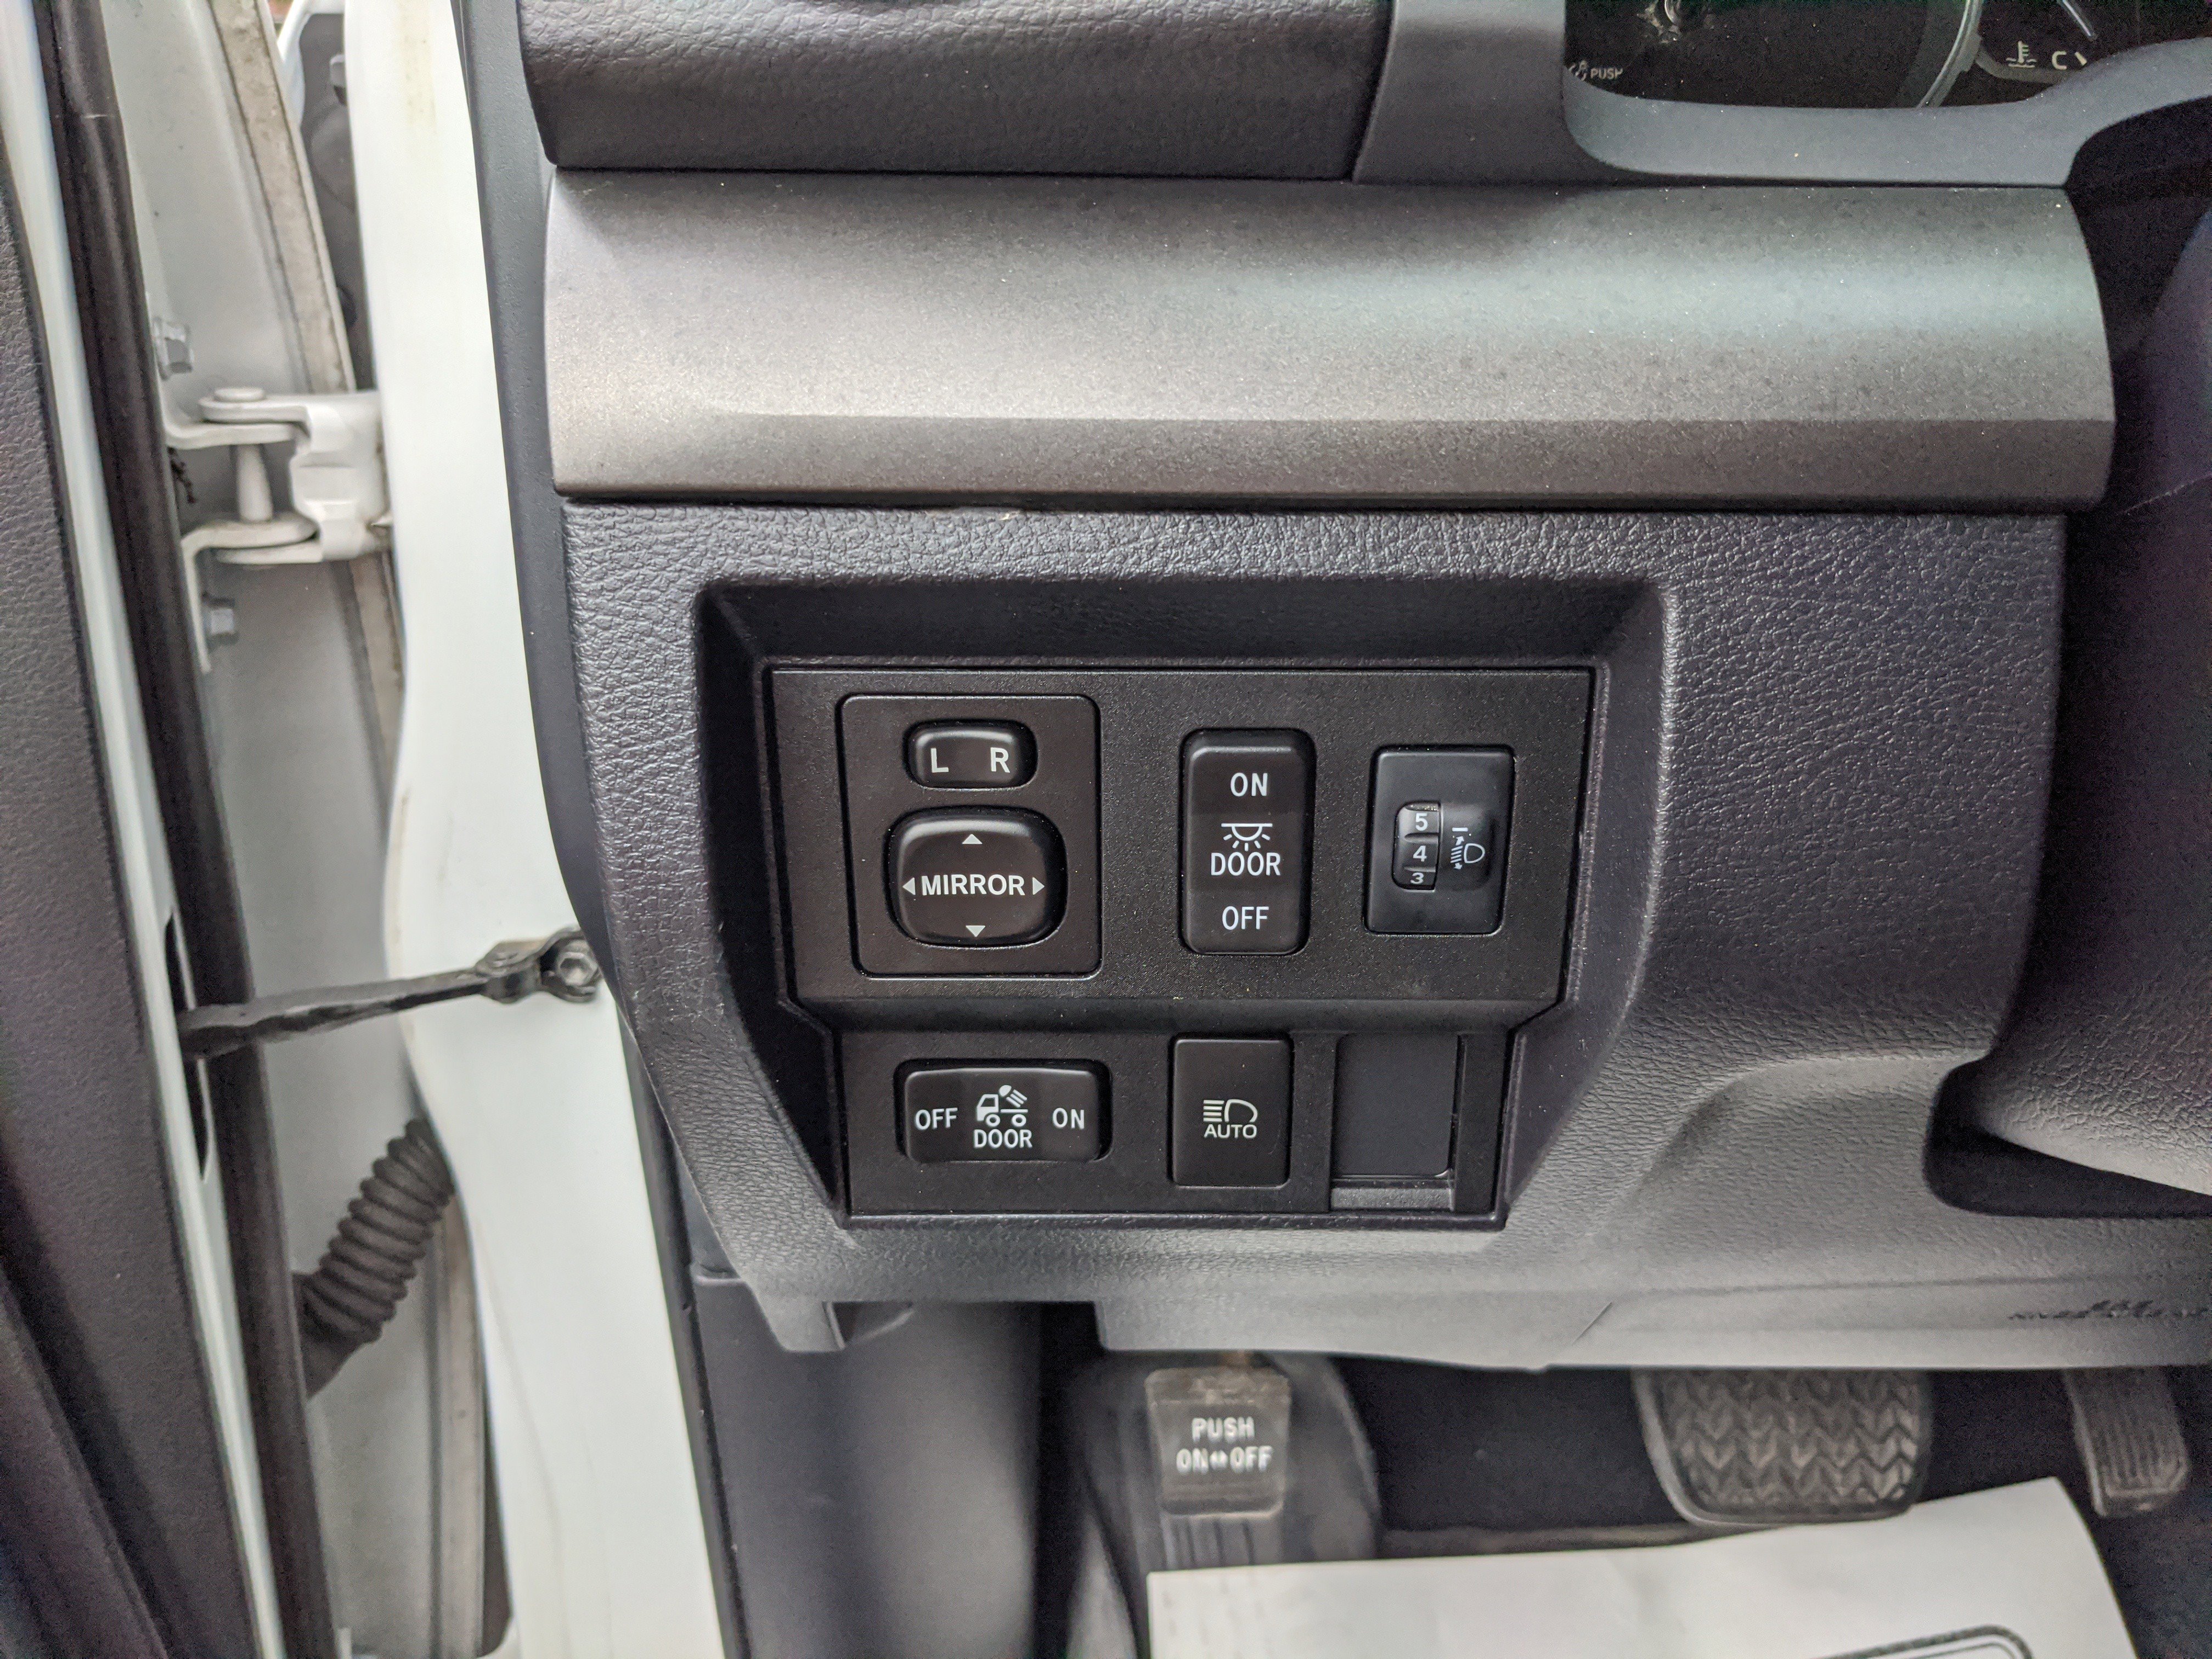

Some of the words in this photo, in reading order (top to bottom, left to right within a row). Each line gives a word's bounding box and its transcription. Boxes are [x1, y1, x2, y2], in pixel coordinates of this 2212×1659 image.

[2051, 50, 2068, 70] C
[930, 747, 949, 773] L
[990, 747, 1011, 773] R
[1229, 772, 1268, 797] ON
[1415, 812, 1428, 832] 5
[1210, 851, 1281, 876] DOOR
[1413, 845, 1427, 862] 4
[921, 874, 1025, 896] MIRROR
[1409, 872, 1424, 885] 3
[1221, 906, 1269, 930] OFF
[914, 1107, 958, 1130] OFF
[1052, 1107, 1085, 1130] ON
[973, 1128, 1032, 1148] DOOR
[1203, 1124, 1257, 1139] AUTO
[1191, 1417, 1255, 1443] PUSH
